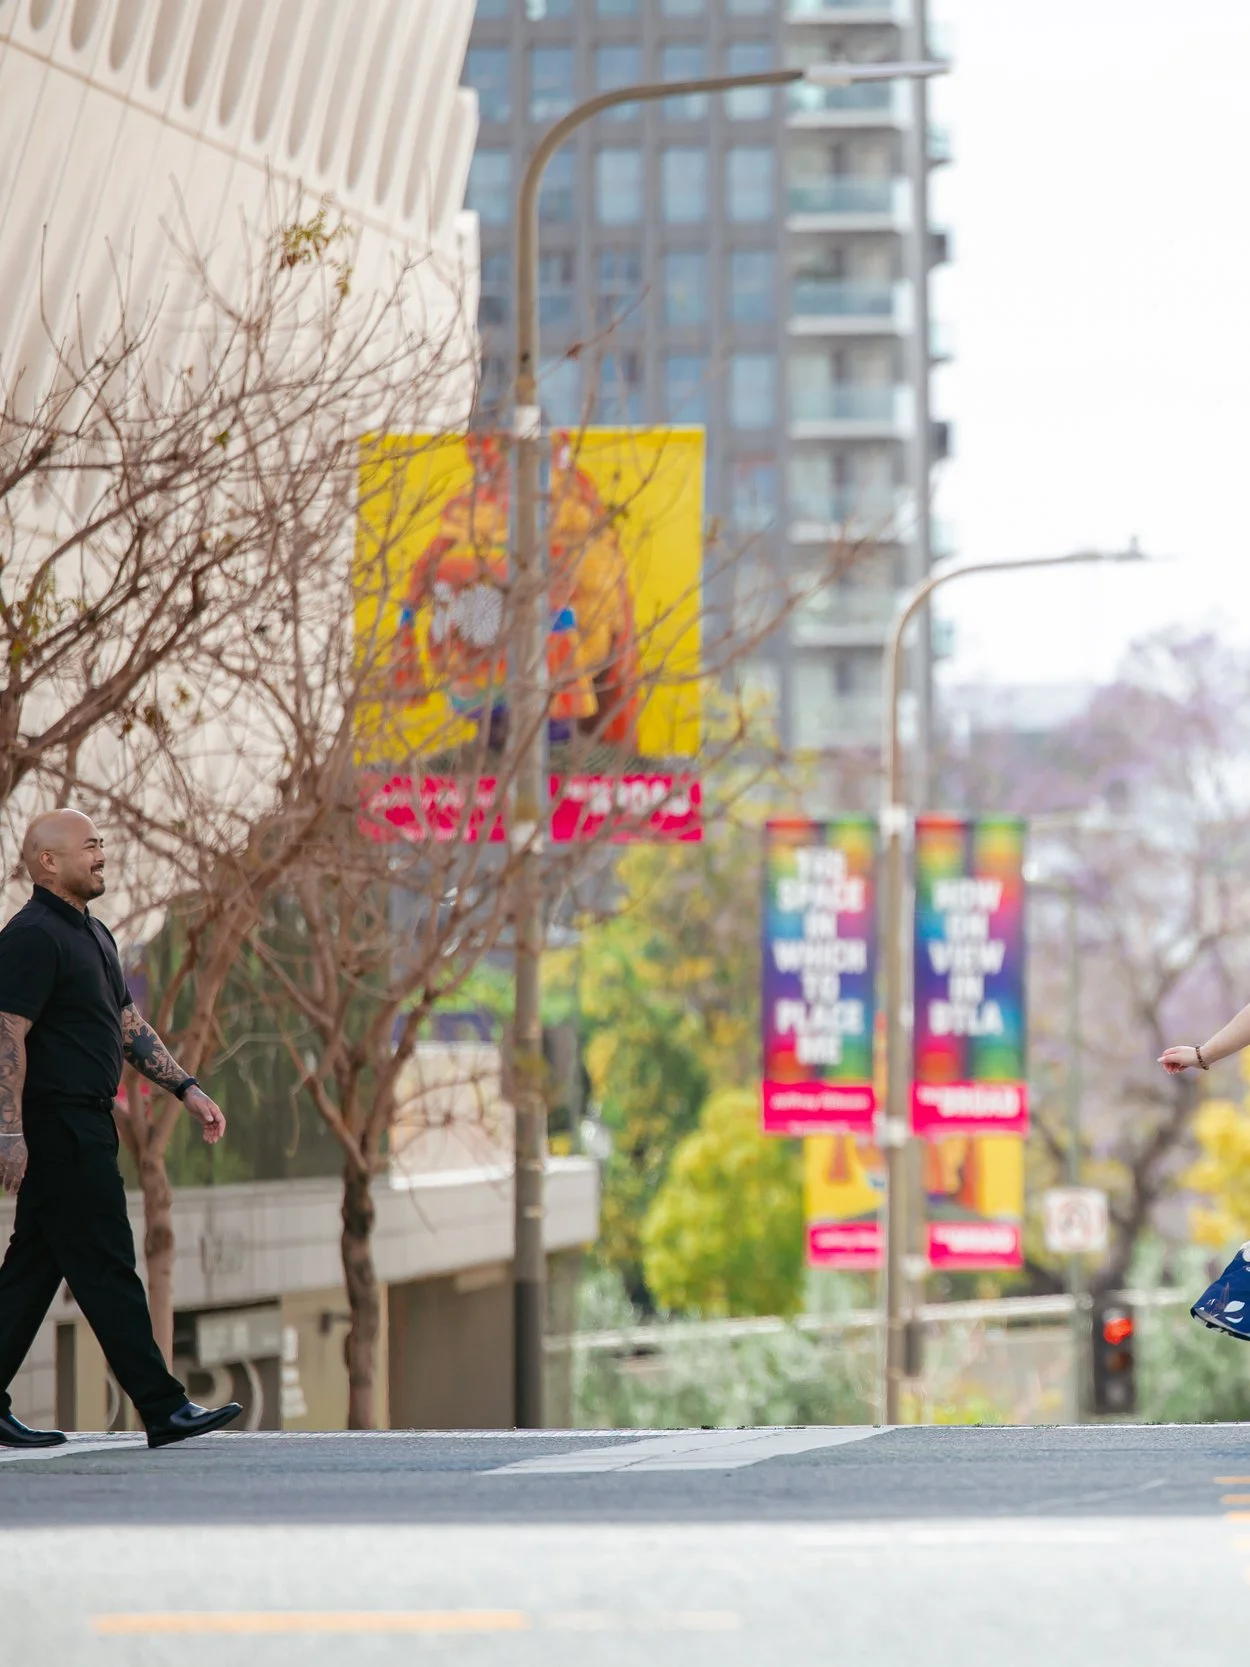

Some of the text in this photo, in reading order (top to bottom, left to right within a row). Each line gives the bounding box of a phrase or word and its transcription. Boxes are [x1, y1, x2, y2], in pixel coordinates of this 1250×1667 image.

[776, 880, 864, 911] SPACE
[932, 880, 1002, 911] NOW
[773, 940, 867, 973] WHICH
[929, 940, 1005, 973] VIEW
[801, 973, 840, 1002] TO
[776, 1001, 863, 1034] PLACE
